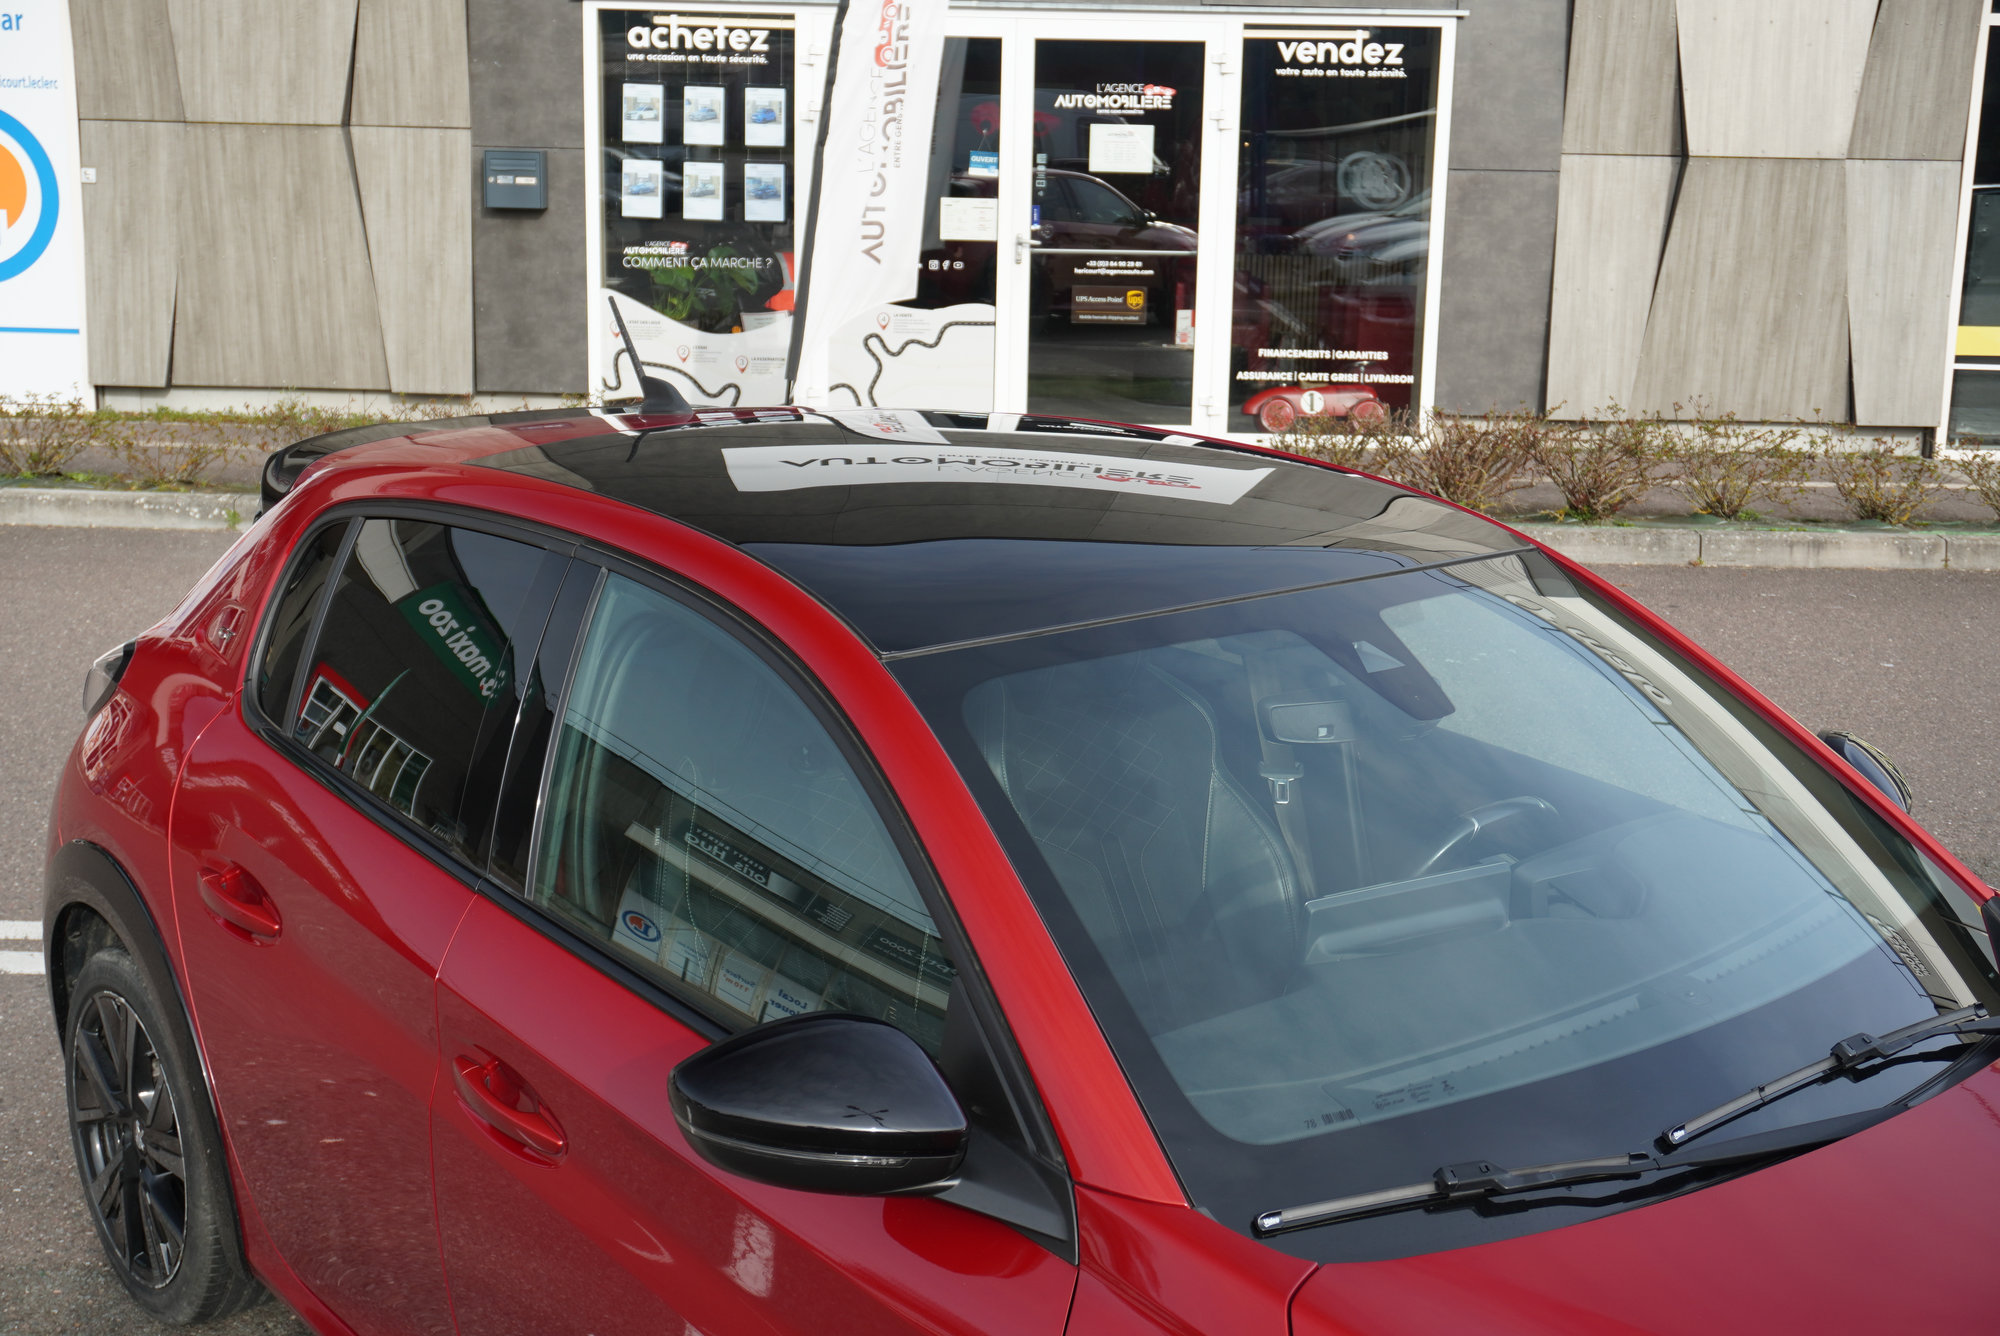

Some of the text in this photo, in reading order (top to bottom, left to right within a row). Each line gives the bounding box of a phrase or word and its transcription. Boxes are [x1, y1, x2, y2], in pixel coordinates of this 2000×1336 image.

[627, 14, 770, 51] achetez
[1277, 29, 1405, 65] vendez
[626, 53, 644, 61] une
[647, 52, 685, 62] occasion
[687, 54, 699, 63] en
[701, 53, 727, 63] toute
[1275, 67, 1300, 76] votre
[1302, 68, 1325, 77] auto
[1326, 69, 1339, 77] en
[1340, 68, 1366, 77] toute
[1096, 83, 1145, 93] L'AGENCE
[622, 256, 774, 271] COMMENT ÇA MARCHE ?
[1258, 348, 1389, 361] FINANCEMENTS GARANTIES
[1236, 371, 1415, 384] ASSURANCE CARTE GRISE LIVRAISON
